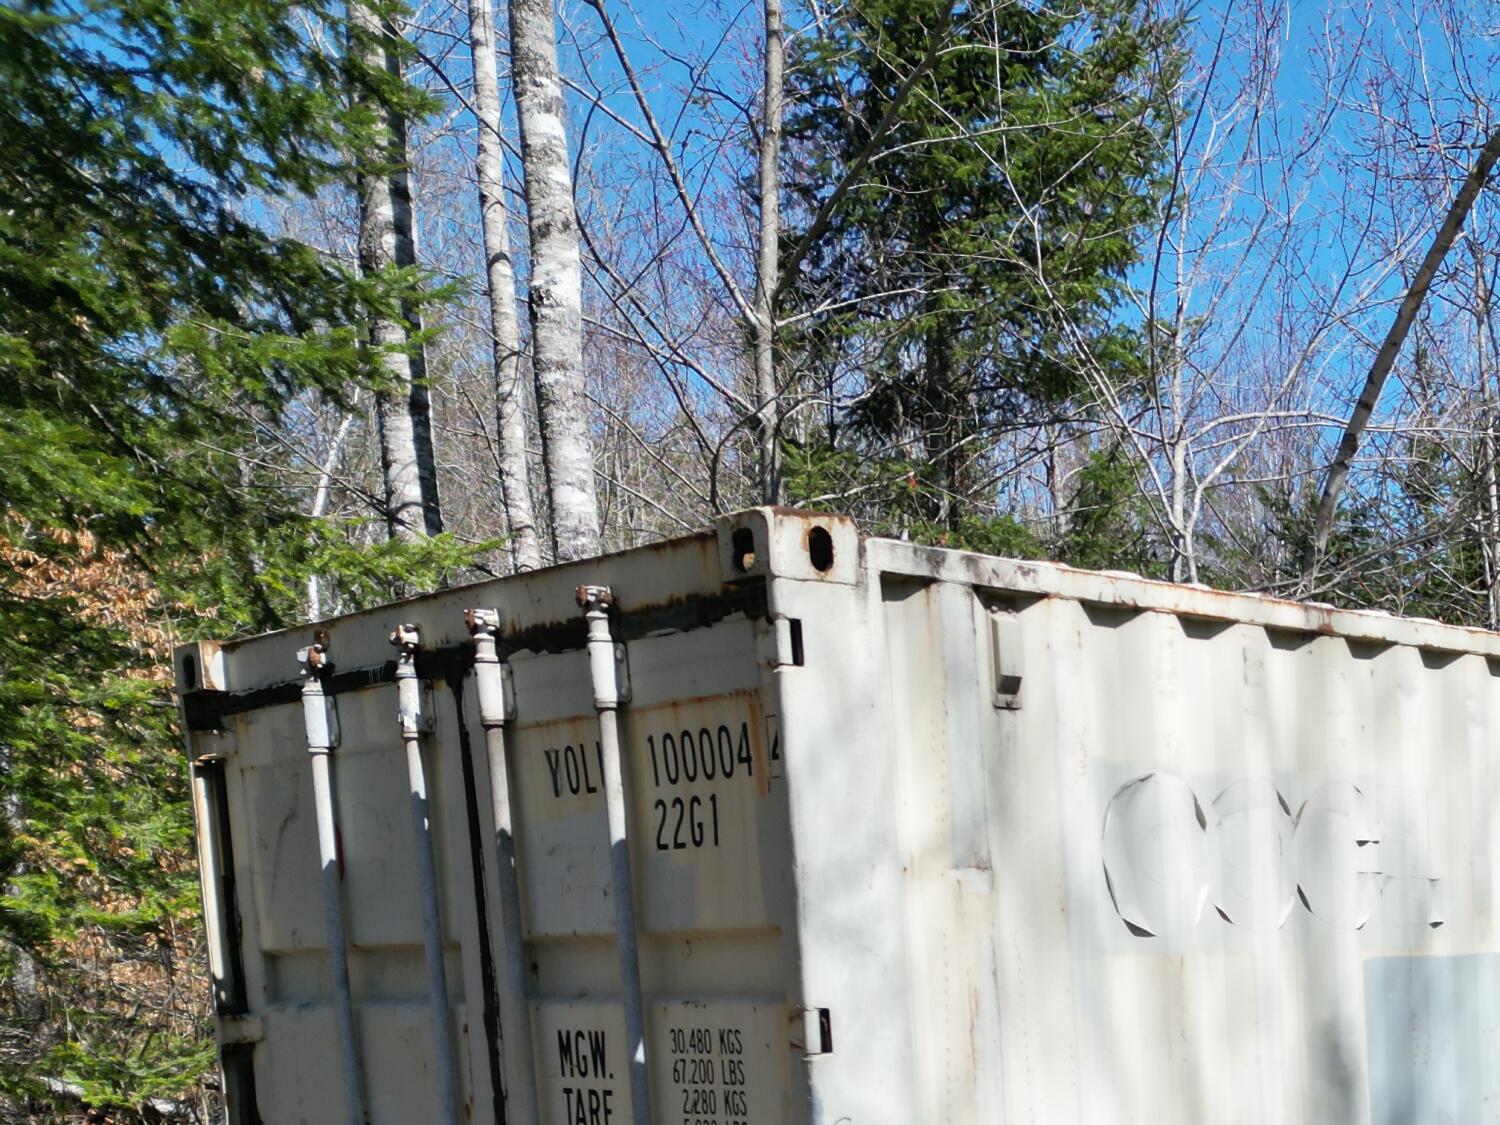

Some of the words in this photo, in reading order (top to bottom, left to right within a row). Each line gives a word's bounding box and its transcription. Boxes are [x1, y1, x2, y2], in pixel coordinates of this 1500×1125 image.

[647, 722, 753, 787] 100004
[654, 793, 719, 850] 22G1
[557, 1029, 614, 1079] MGW.
[669, 1028, 712, 1054] 30.480
[719, 1028, 743, 1055] KGS
[673, 1059, 714, 1085] 67.200
[721, 1059, 745, 1086] LBS
[723, 1089, 748, 1116] KGS
